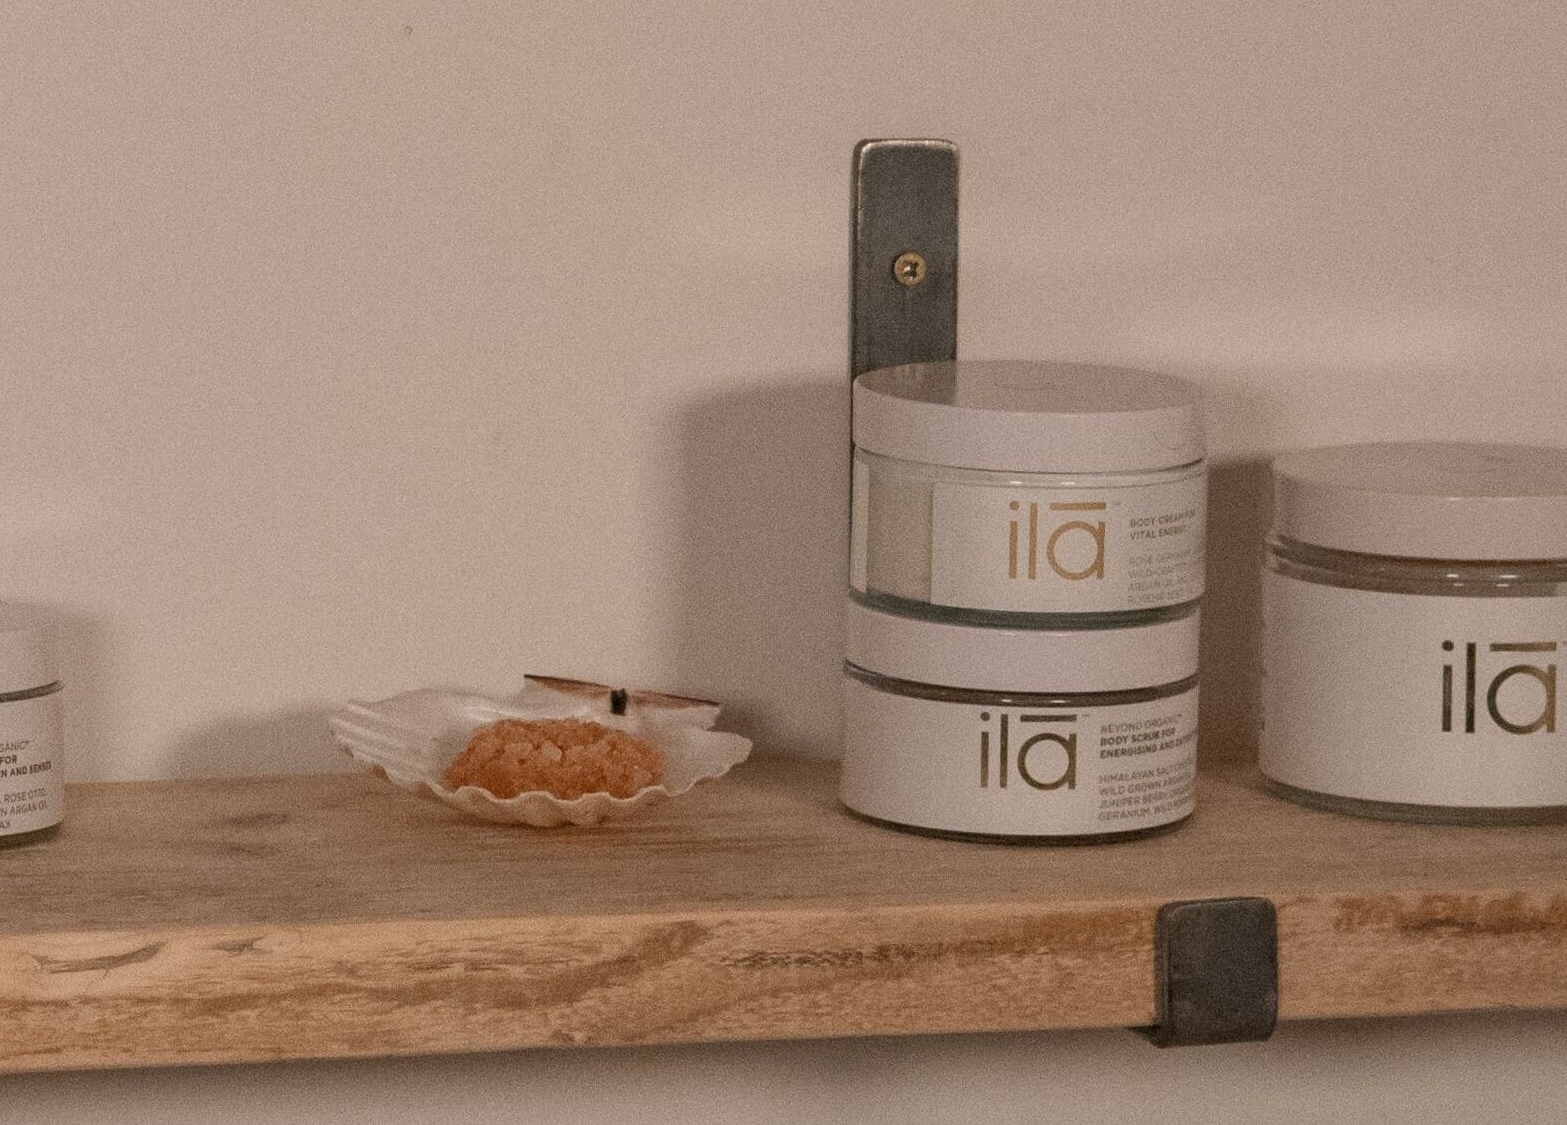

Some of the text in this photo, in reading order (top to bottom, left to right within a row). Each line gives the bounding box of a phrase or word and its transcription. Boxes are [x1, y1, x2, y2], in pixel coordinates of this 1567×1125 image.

[1100, 736, 1129, 747] BODY
[1131, 731, 1160, 743] SCRUB
[0, 754, 18, 765] FOR
[9, 765, 28, 776] AND
[3, 792, 27, 803] ROSE
